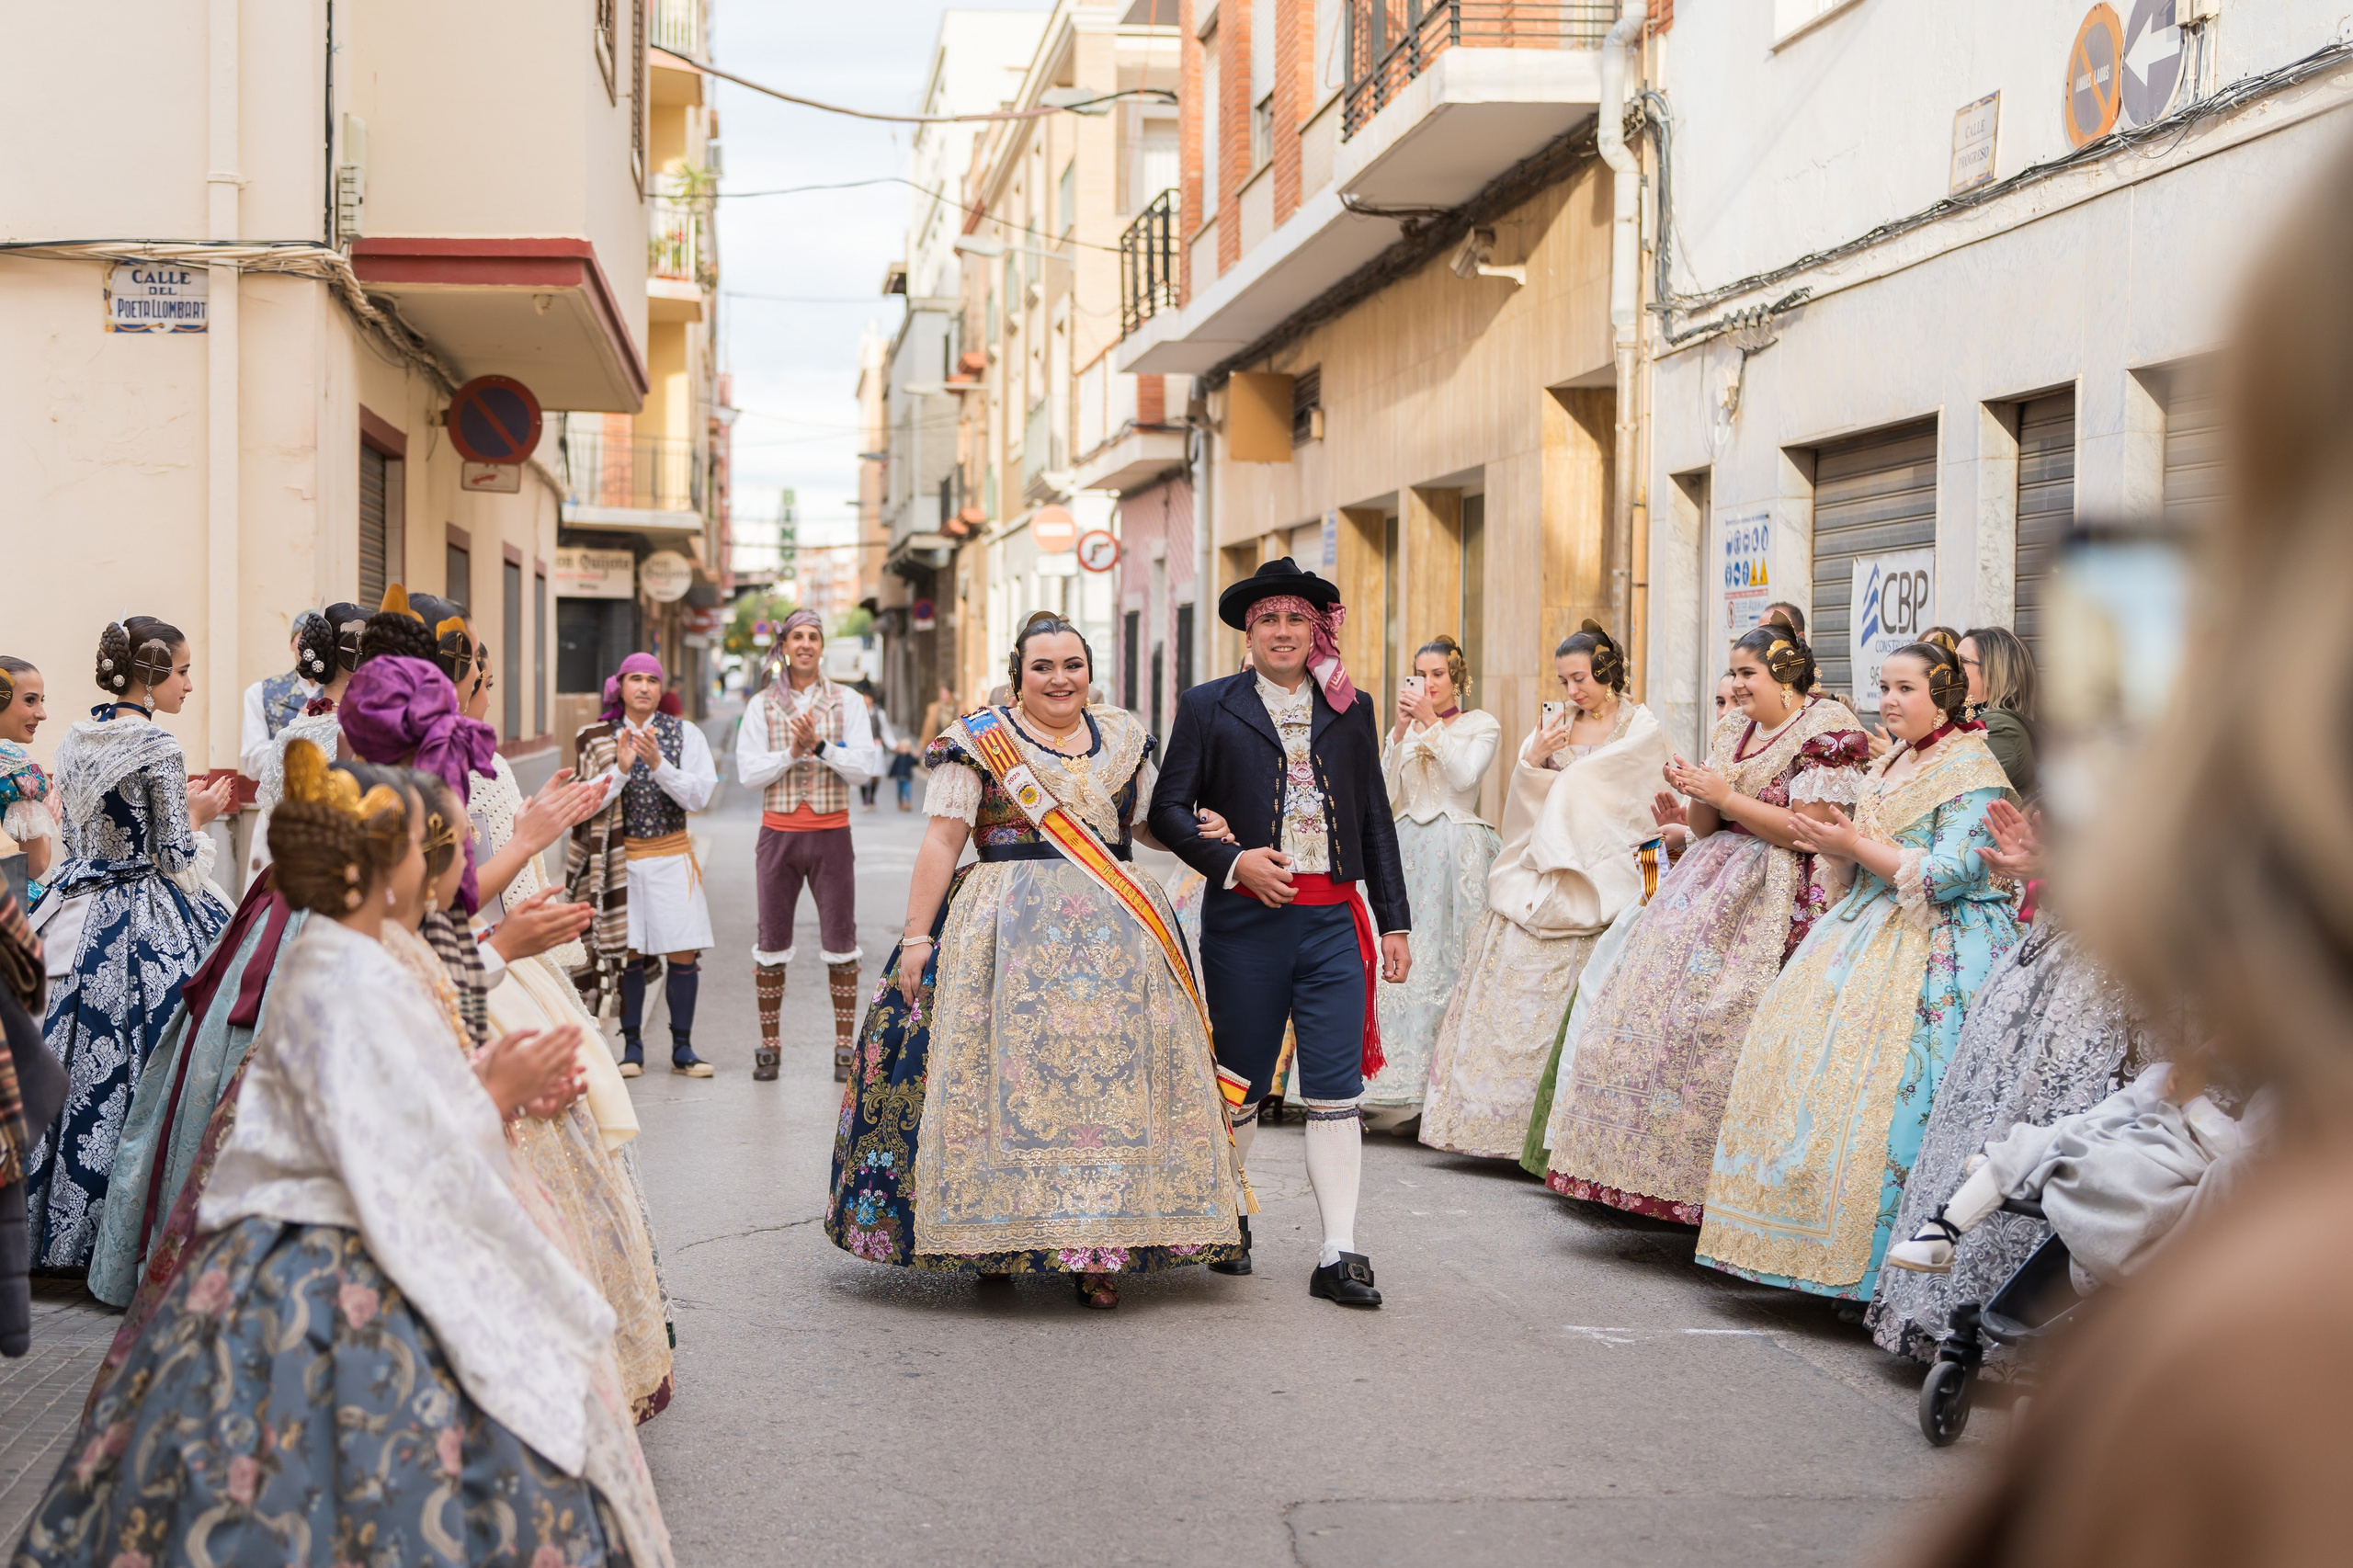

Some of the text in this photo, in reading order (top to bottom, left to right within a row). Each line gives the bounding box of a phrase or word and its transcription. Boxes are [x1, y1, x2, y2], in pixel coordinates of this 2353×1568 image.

[2075, 64, 2109, 93] AMBOS LADOS
[1965, 119, 1985, 140] CALLE
[1957, 145, 1989, 171] PROGRESO
[131, 269, 191, 284] CALLE
[149, 287, 177, 295] DEL
[779, 488, 796, 581] BINGO
[556, 556, 574, 567] on
[579, 554, 630, 580] Quijote
[1881, 569, 1928, 634] CBP
[1875, 638, 1916, 653] CONSTRU
[1006, 771, 1021, 785] 2025
[1098, 864, 1146, 912] Fallera
